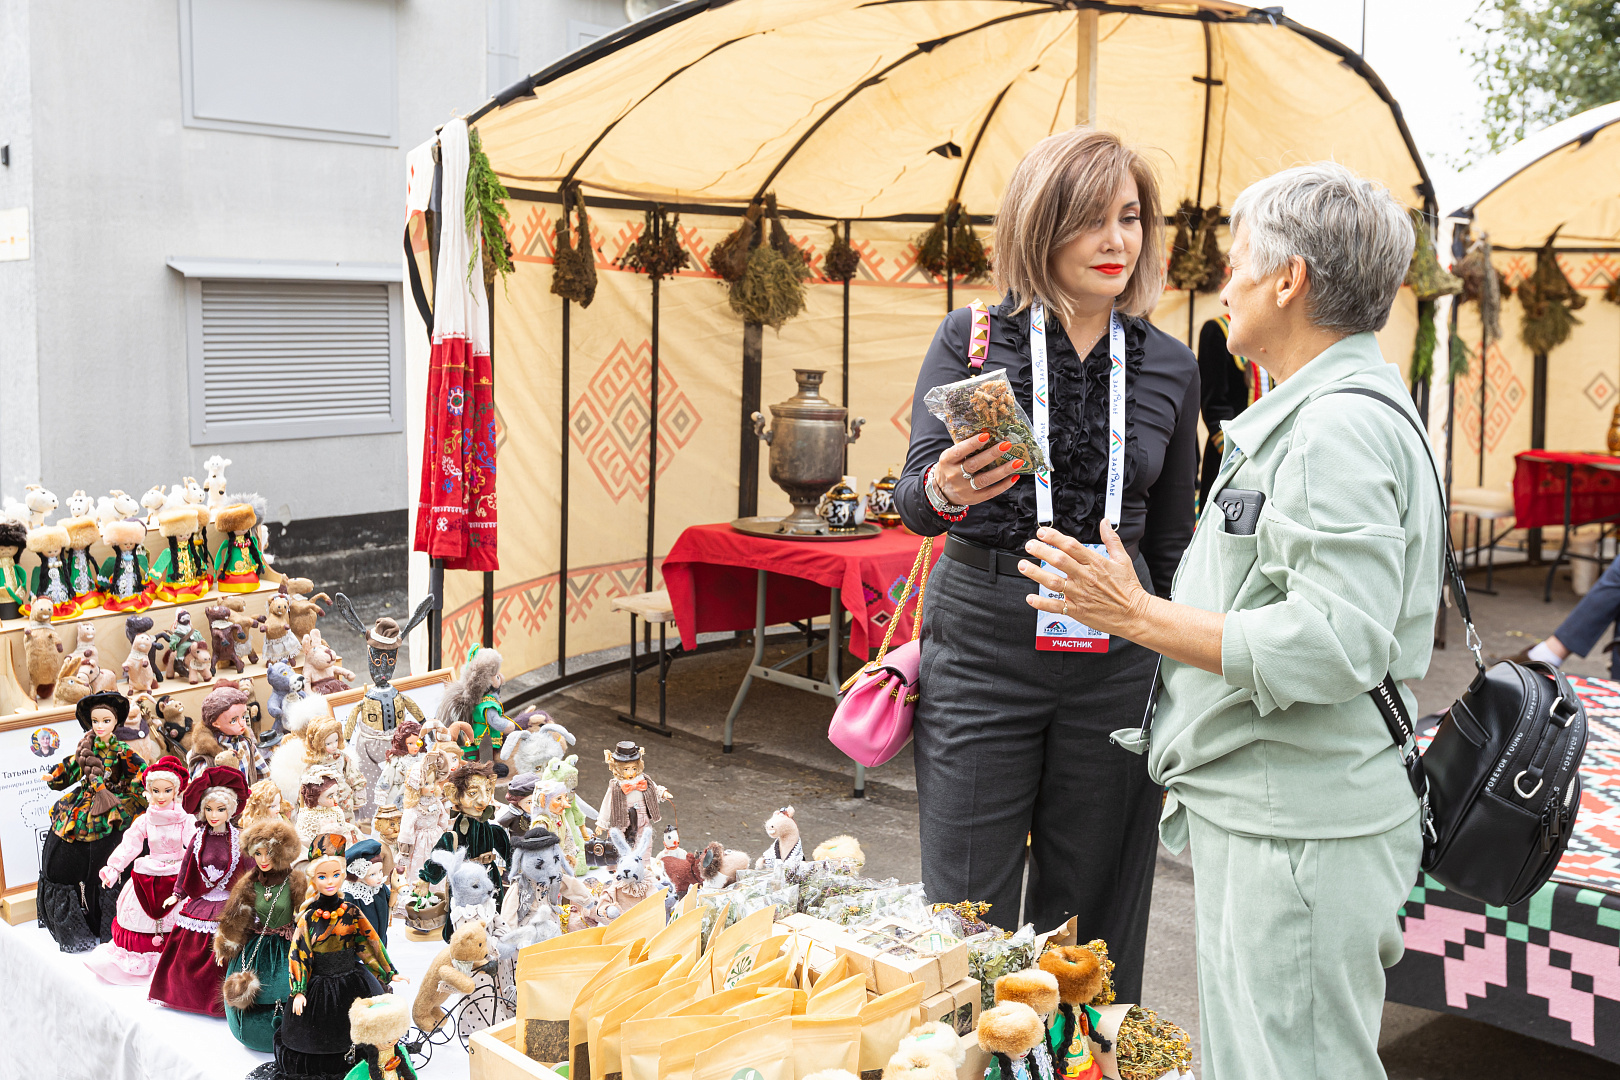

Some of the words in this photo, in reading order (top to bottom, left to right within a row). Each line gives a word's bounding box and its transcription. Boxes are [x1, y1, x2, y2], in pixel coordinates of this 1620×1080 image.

[1109, 457, 1121, 496] ЗАУРАЛЬЕ
[1052, 639, 1093, 649] УЧАСТНИК
[2, 767, 38, 780] Татьяна
[1484, 757, 1508, 792] FOREVOR
[1505, 732, 1524, 757] YOUNG
